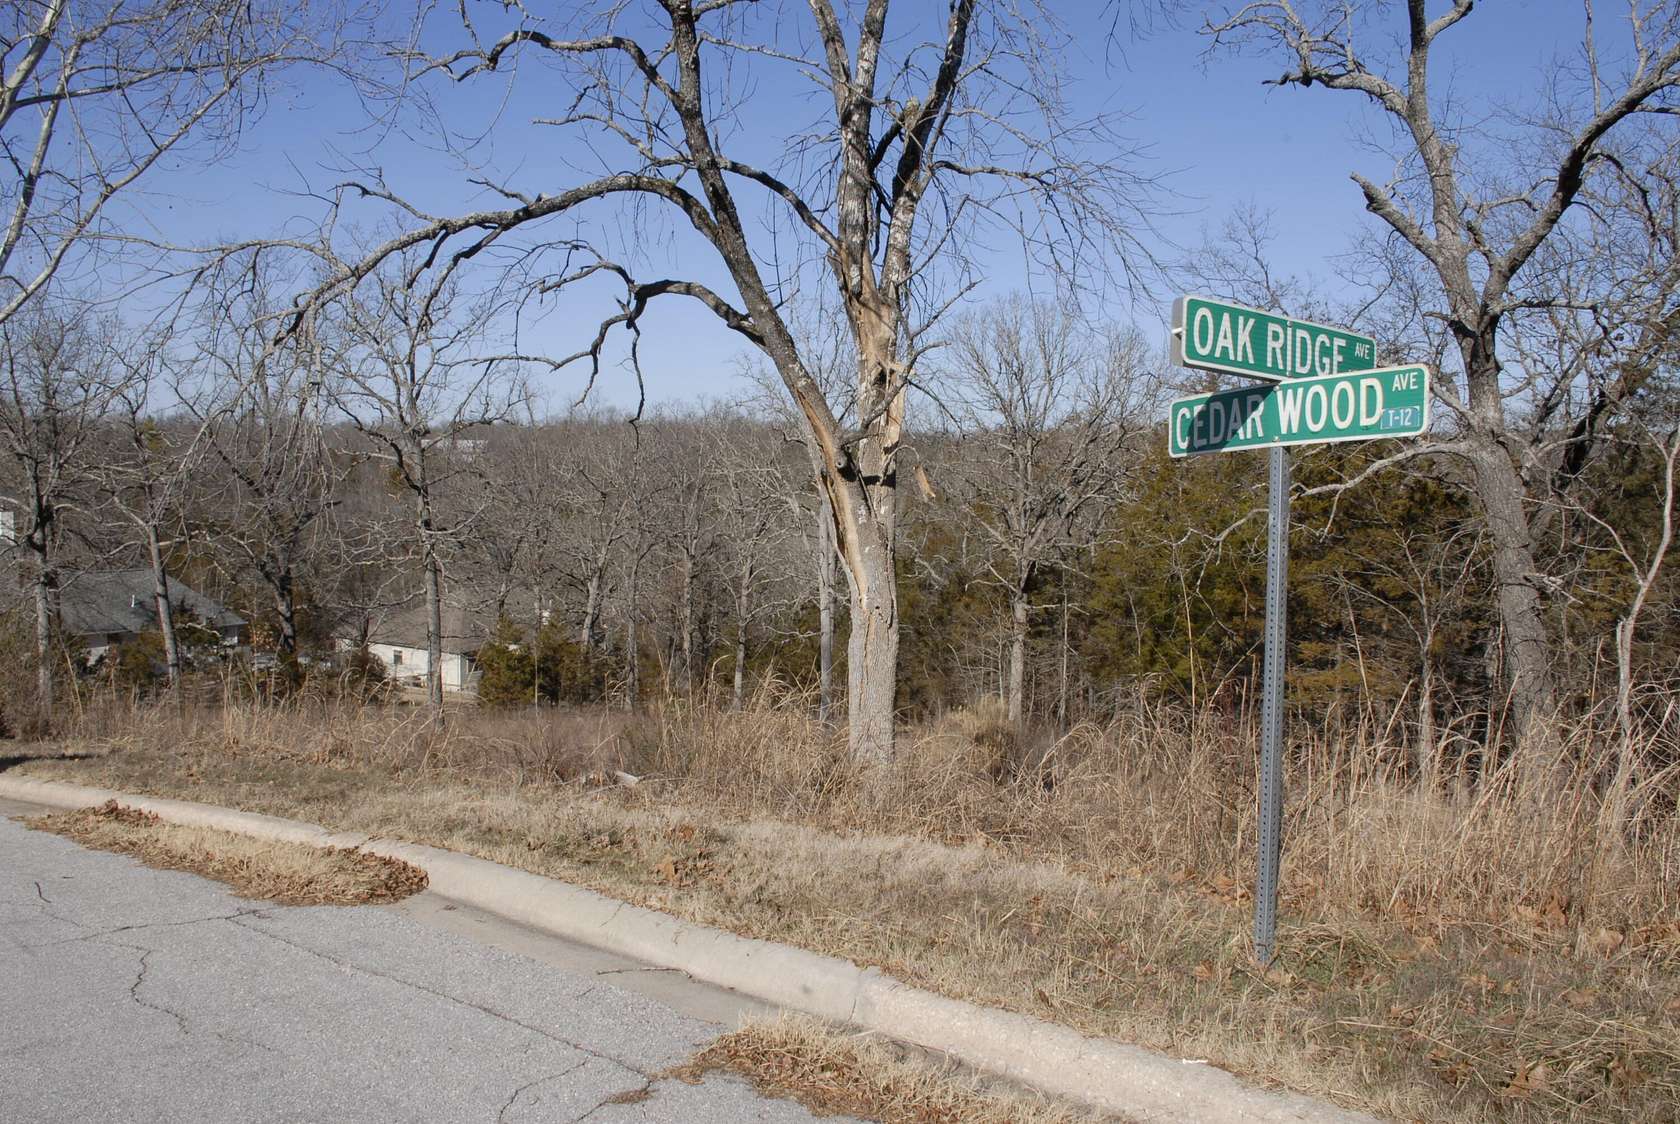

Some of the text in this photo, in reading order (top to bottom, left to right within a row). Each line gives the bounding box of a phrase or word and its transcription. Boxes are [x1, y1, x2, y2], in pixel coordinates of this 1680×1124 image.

[1193, 307, 1371, 377] OAK RIDGE AVE
[1176, 372, 1418, 450] CEDAR WOOD AVE
[1387, 408, 1412, 427] T-12
